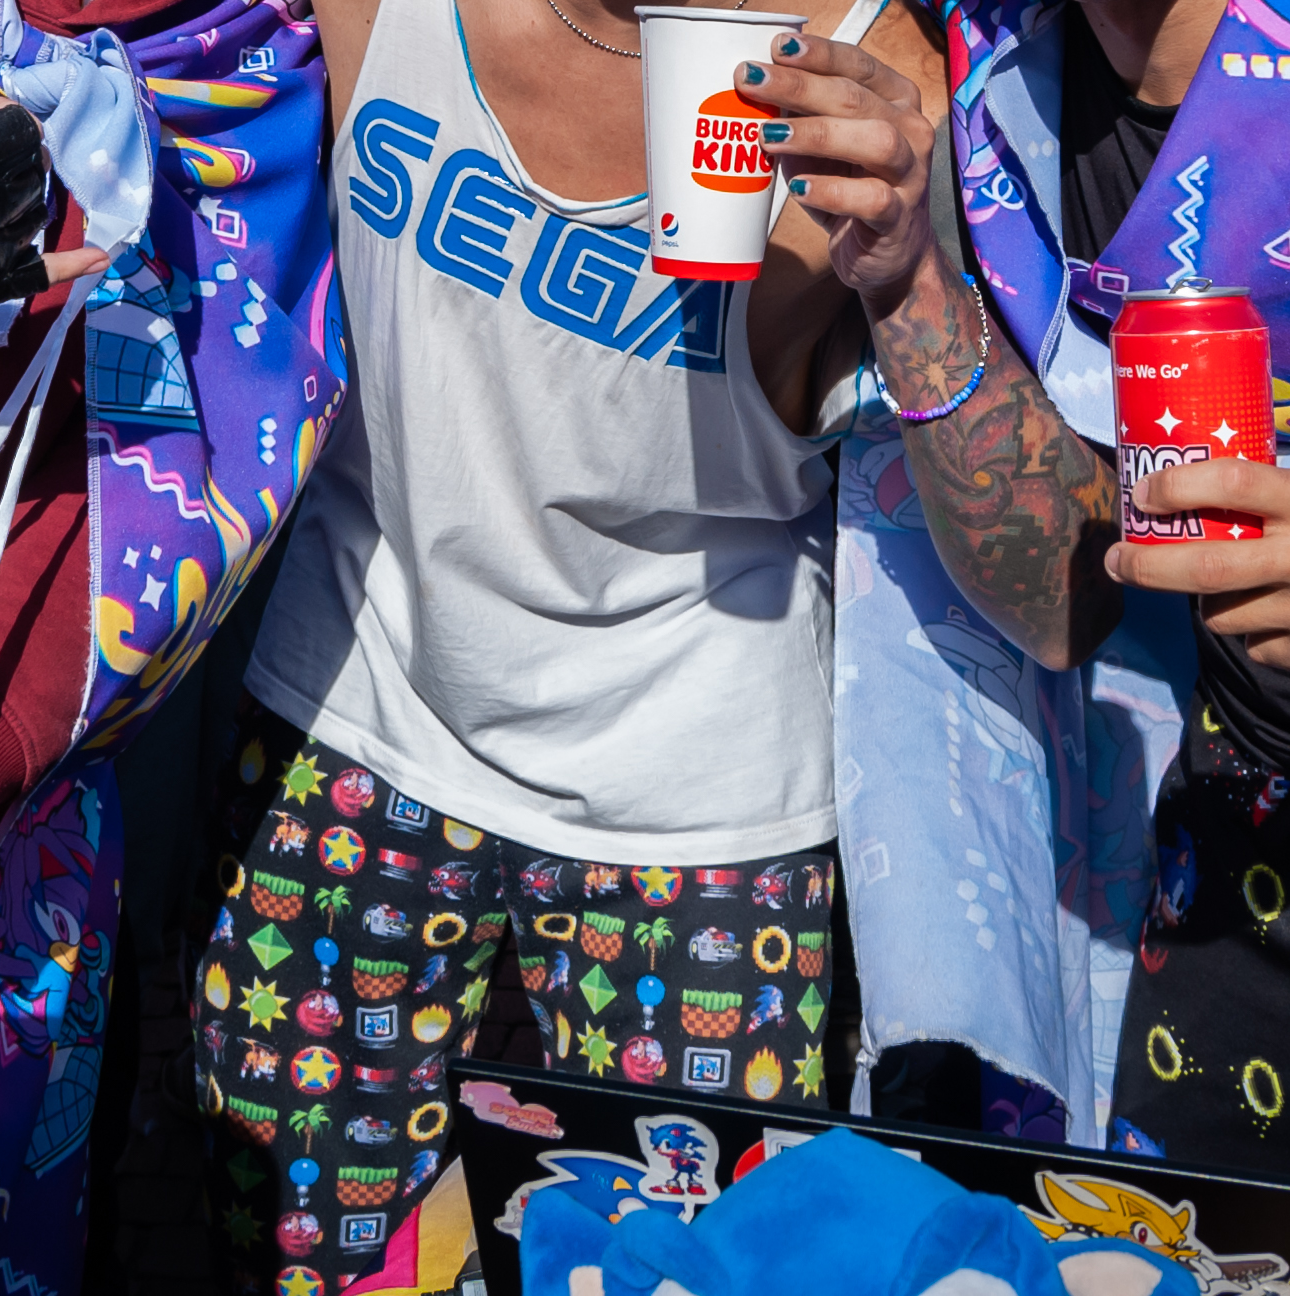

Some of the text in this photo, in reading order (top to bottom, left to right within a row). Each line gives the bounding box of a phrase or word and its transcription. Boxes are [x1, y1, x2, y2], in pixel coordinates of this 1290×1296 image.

[695, 117, 760, 143] BURG
[349, 98, 734, 374] SEGA
[1135, 364, 1156, 379] We
